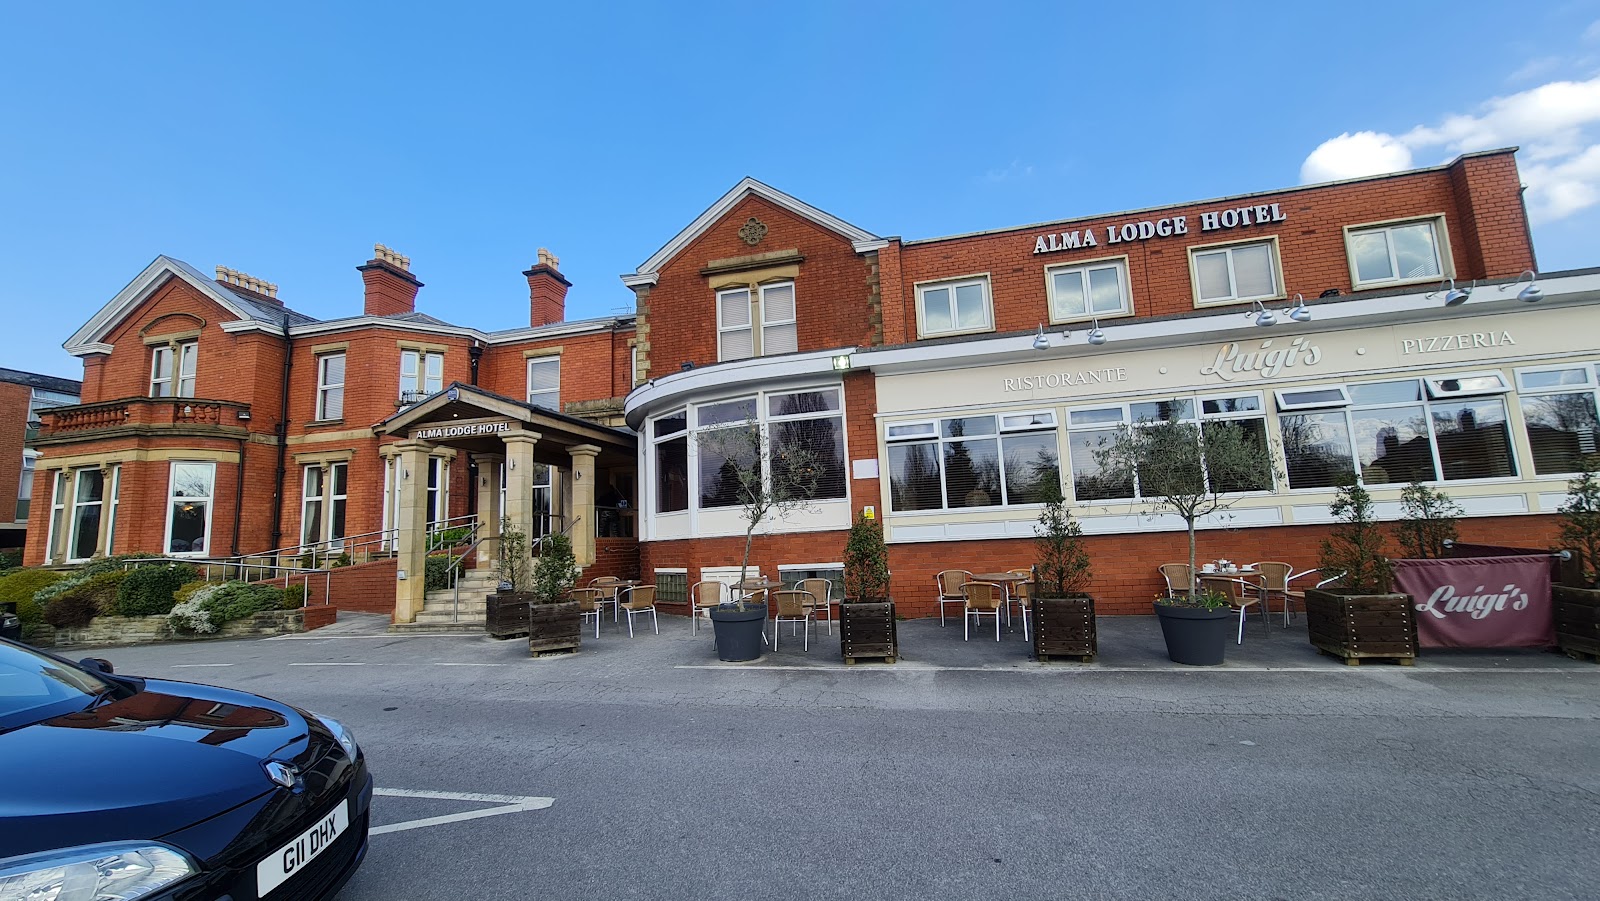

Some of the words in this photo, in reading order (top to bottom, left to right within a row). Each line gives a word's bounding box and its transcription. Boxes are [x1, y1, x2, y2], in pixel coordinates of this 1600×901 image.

[1033, 229, 1098, 254] ALMA
[1107, 216, 1188, 244] LODGE
[1200, 203, 1286, 231] HOTEL
[1003, 367, 1128, 392] RISTORANTE
[1200, 337, 1322, 381] Luigi's
[1402, 330, 1516, 354] PIZZERIA
[416, 430, 442, 439] ALMA
[445, 425, 477, 436] LODGE
[479, 422, 510, 433] HOTEL
[1415, 584, 1529, 620] Luigi's
[309, 813, 337, 856] DHX
